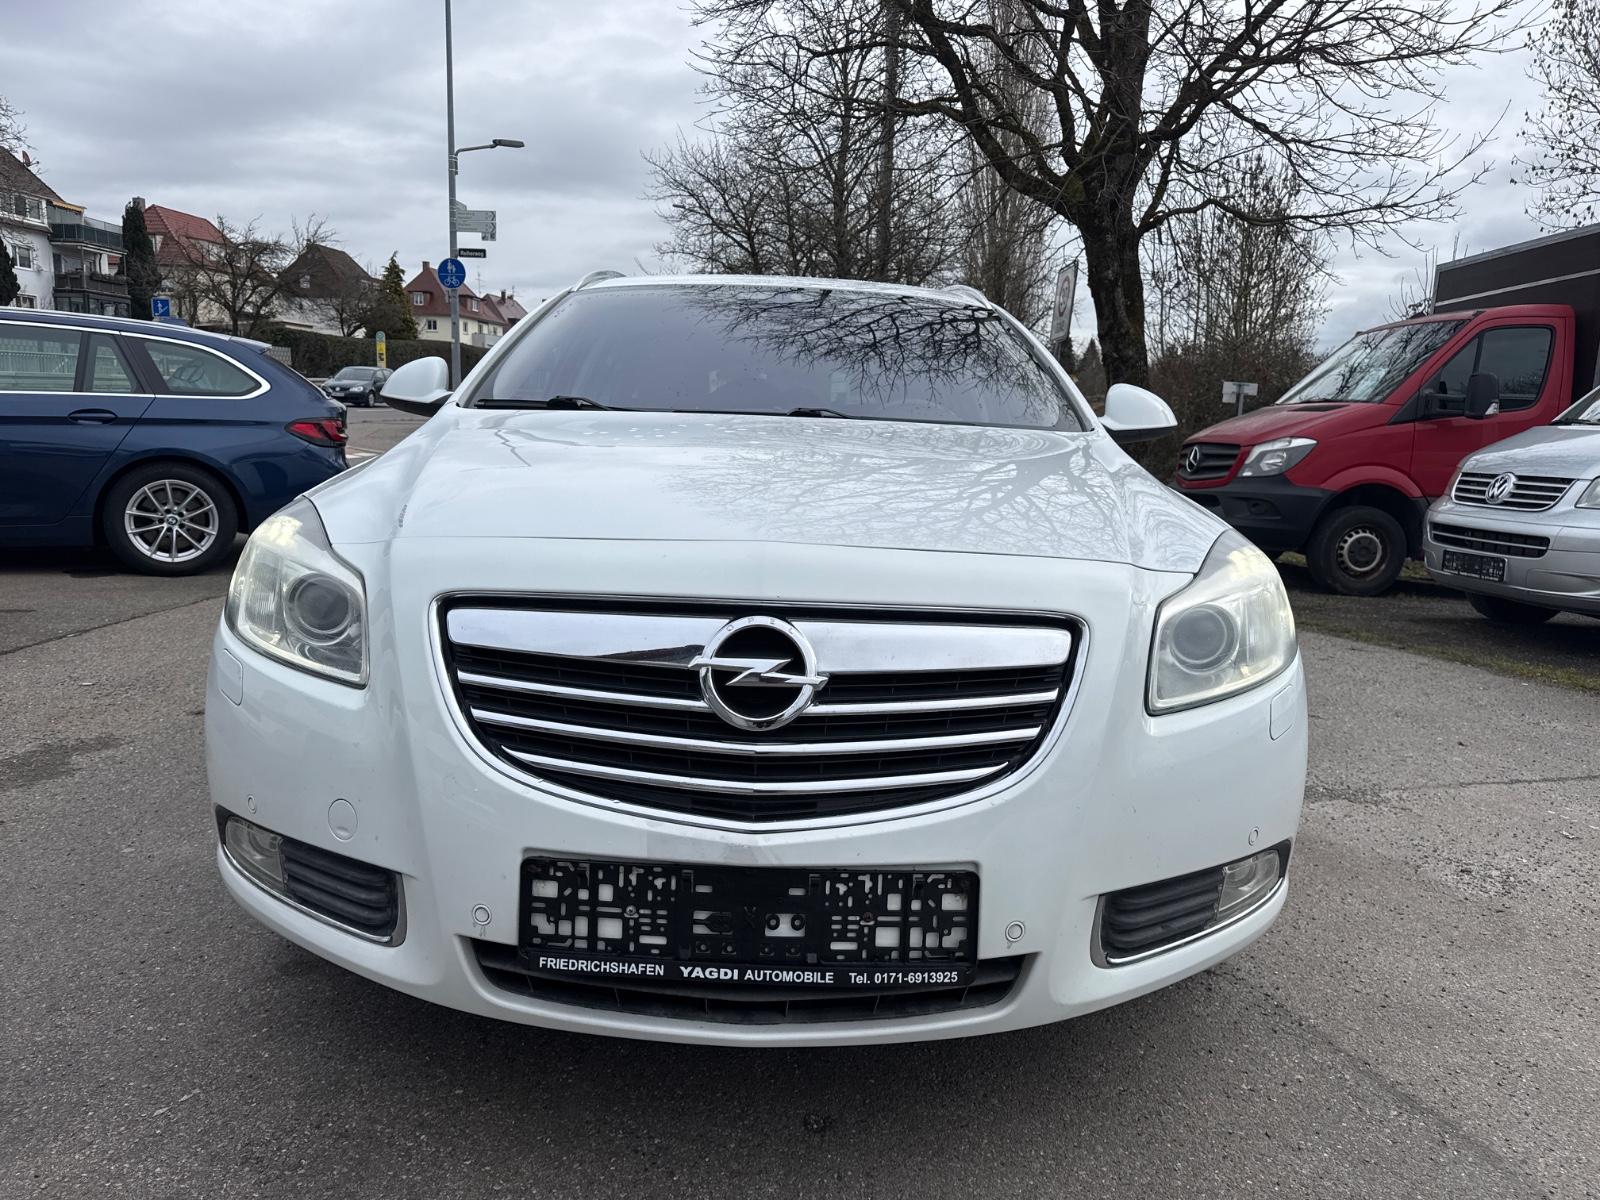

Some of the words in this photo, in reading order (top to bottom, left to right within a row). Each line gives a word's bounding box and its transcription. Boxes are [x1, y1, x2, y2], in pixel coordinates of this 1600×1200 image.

[726, 617, 795, 635] OPEL
[539, 957, 665, 976] FRIEDRICHSHAFEN
[679, 966, 739, 980] YAGDI
[744, 969, 834, 984] AUTOMOBILE
[849, 972, 871, 984] Tel.
[874, 971, 958, 984] 0171-6913925
